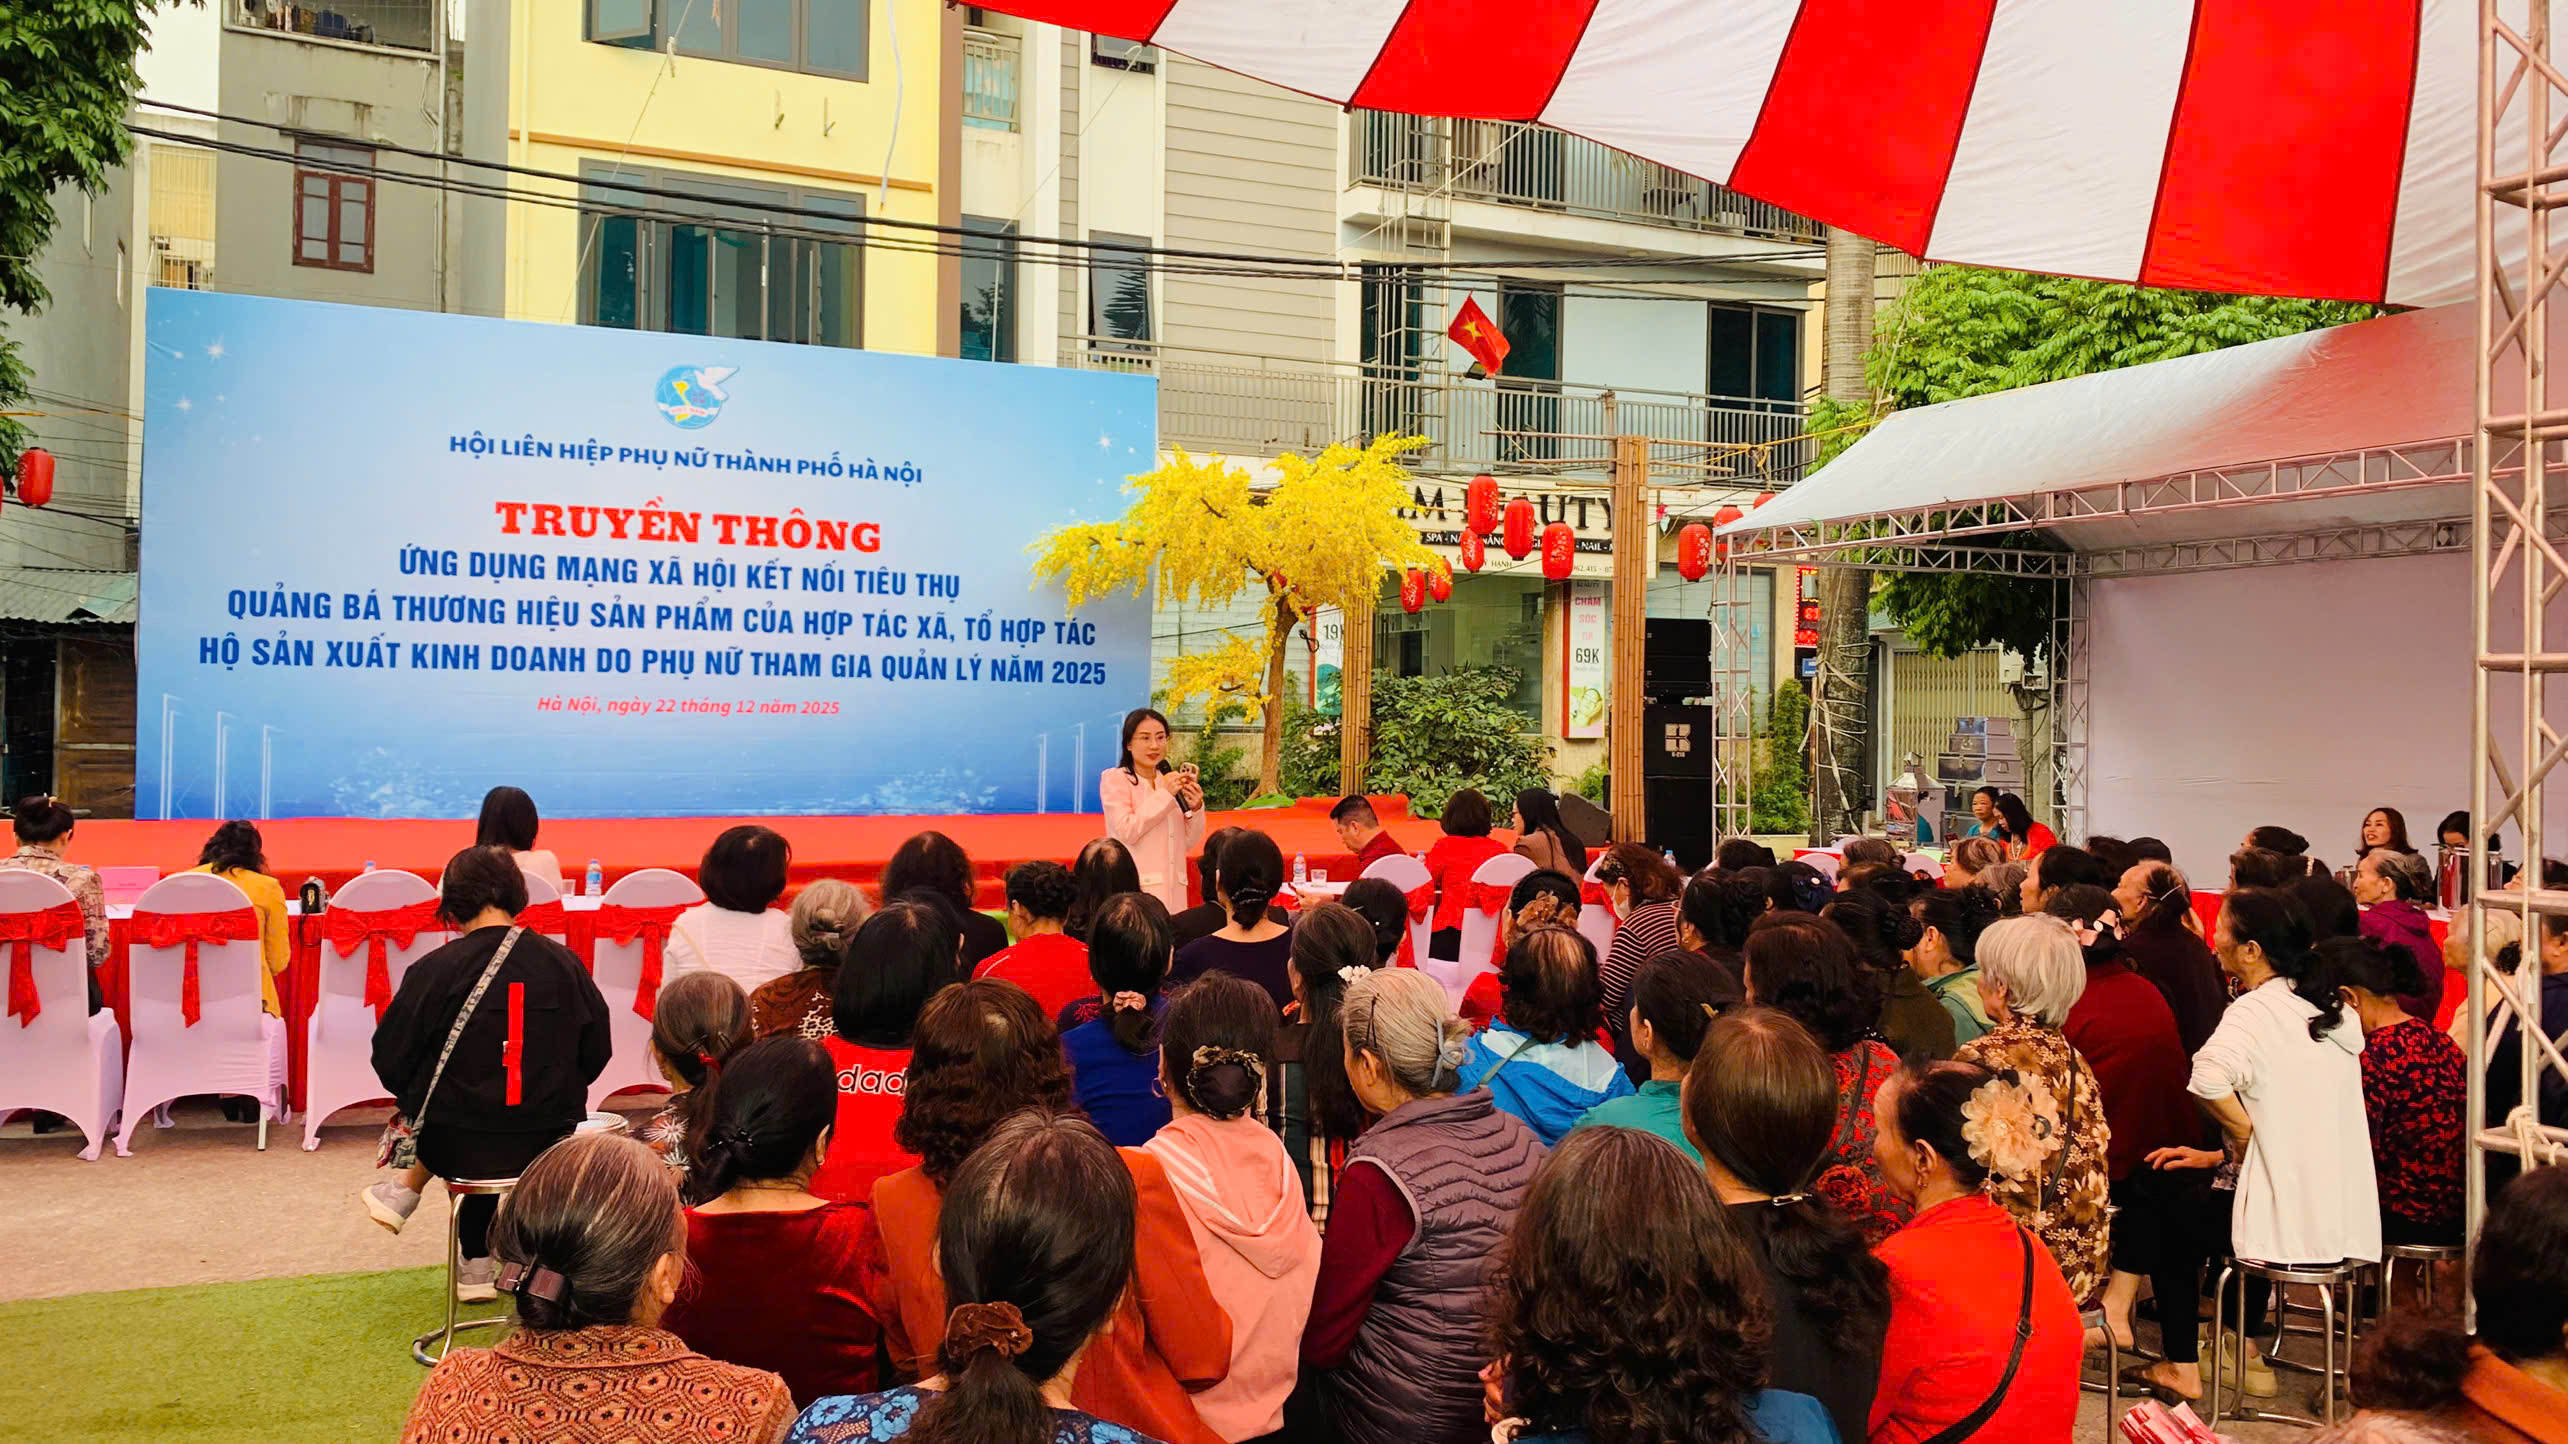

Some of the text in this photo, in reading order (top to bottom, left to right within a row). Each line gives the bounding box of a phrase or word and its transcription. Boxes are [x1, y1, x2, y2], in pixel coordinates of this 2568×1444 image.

[450, 430, 923, 487] HỘI LIÊN HIỆP PHỤ NỮ THÀNH PHỐ HÀ NỘI
[495, 496, 881, 553] TRUYỀN THÔNG
[399, 543, 960, 603] ỨNG DỤNG MẠNG XÃ HỘI KẾT NỐI TIÊU THỤ
[228, 582, 1096, 648] QUẢNG BÁ THƯƠNG HIỆU SẢN PHẨM CỦA HỢP TÁC XÃ, TỔ HỢP TÁC
[199, 631, 1106, 685] HỘ SẢN XUẤT KINH DOANH DO PHỤ NỮ THAM GIA QUẢN LÝ NĂM 2025
[1575, 647, 1600, 663] 69K
[537, 695, 841, 717] Hà Nội, ngày 22 tháng 12 năm 2025
